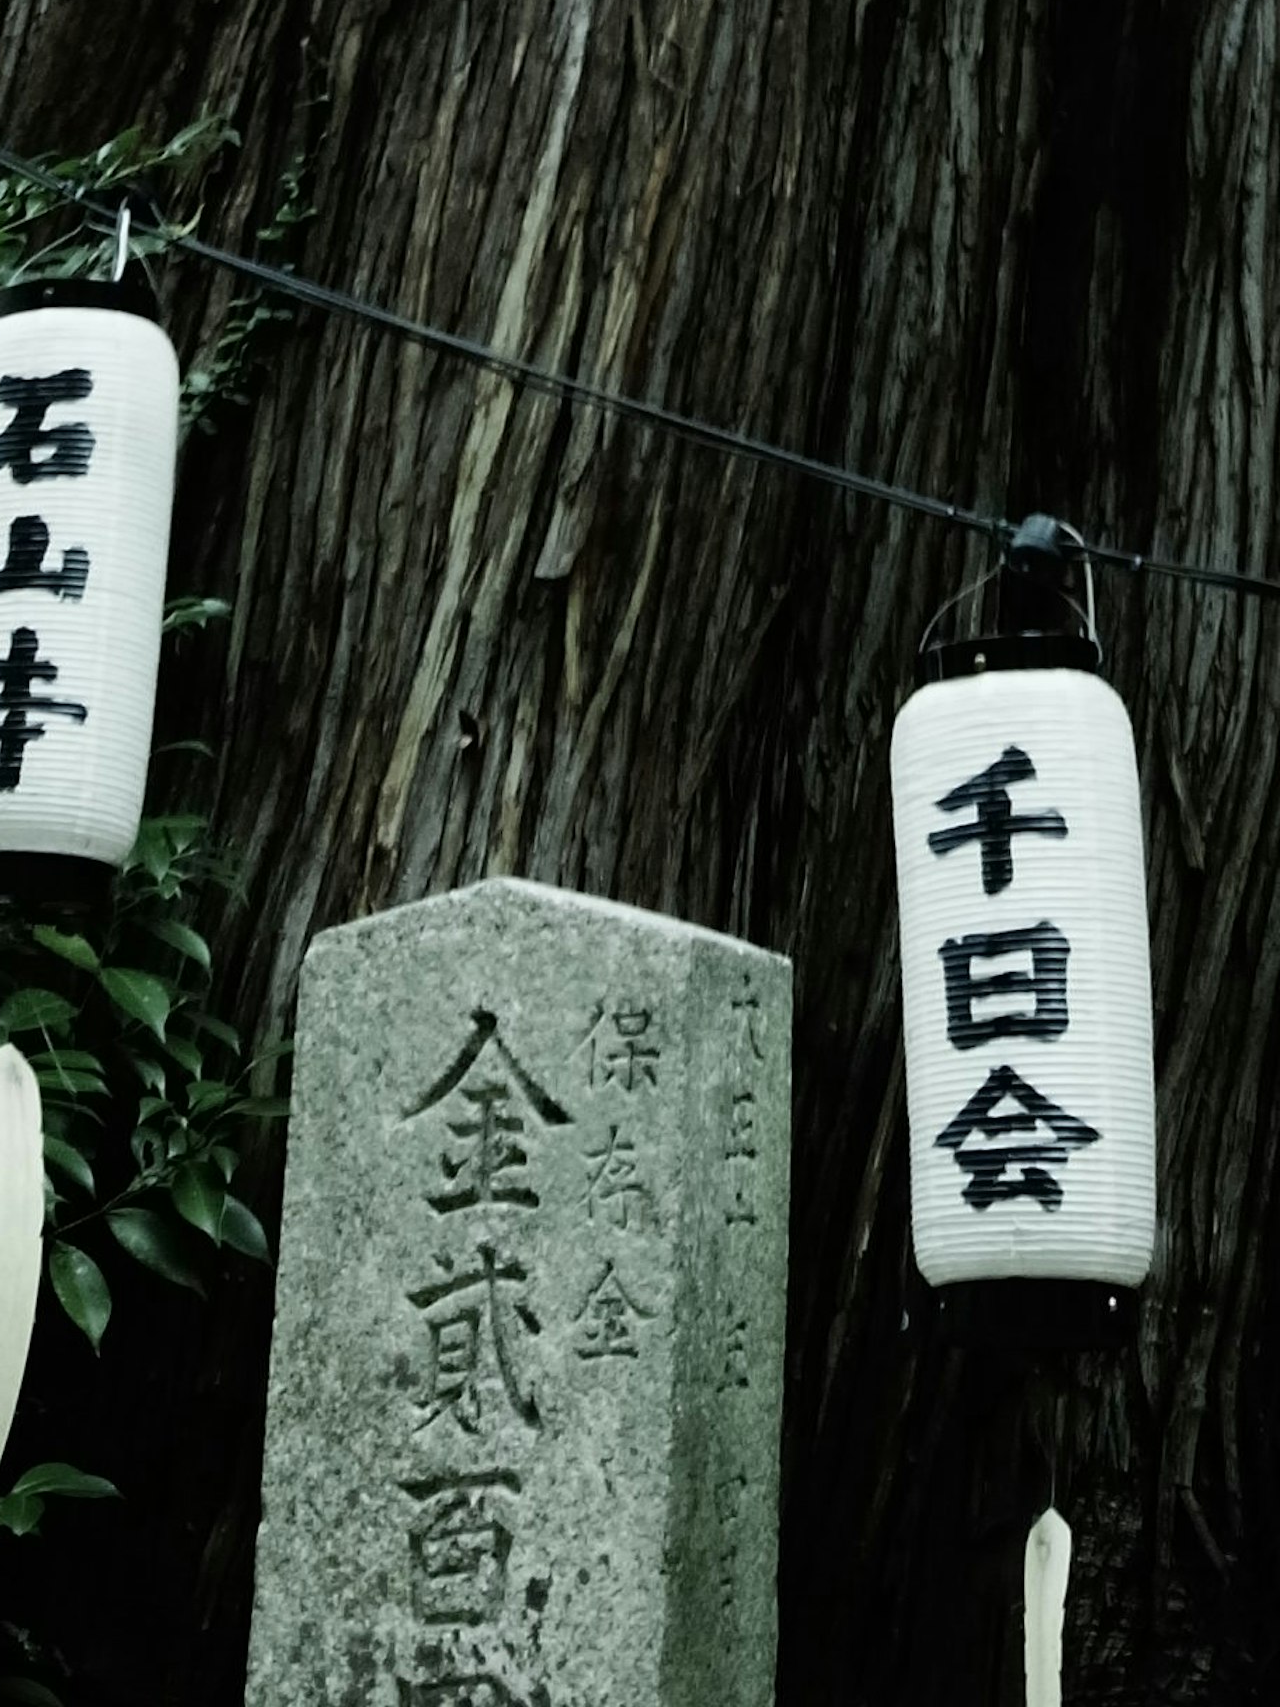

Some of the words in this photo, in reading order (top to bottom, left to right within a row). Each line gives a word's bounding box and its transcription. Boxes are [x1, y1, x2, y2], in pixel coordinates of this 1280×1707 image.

[565, 1001, 660, 1361] 保存金
[928, 744, 1103, 1211] 千日会
[393, 1007, 574, 1707] 金貳百
